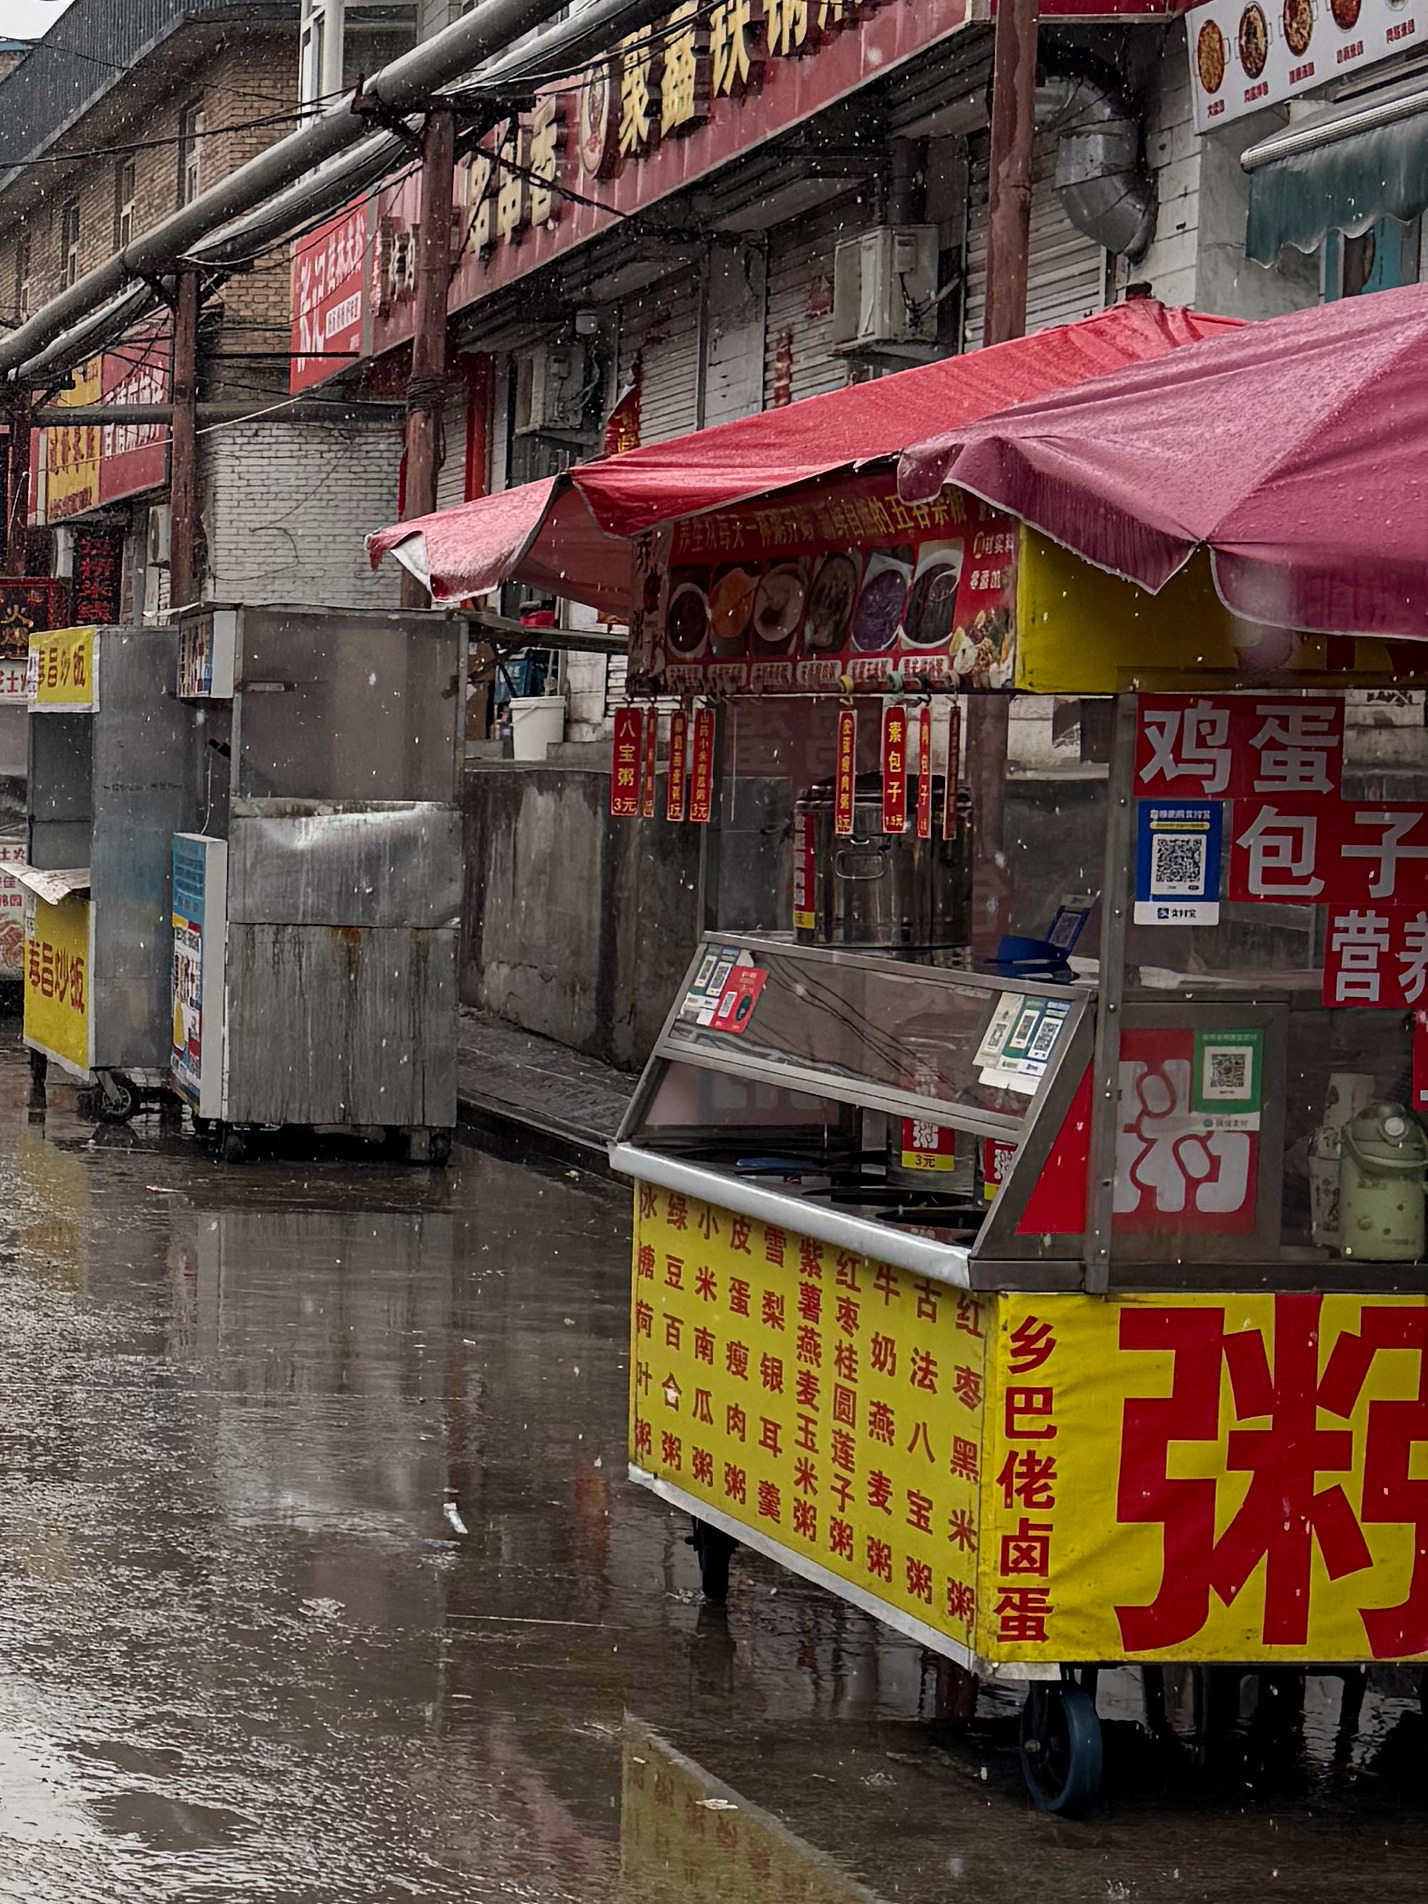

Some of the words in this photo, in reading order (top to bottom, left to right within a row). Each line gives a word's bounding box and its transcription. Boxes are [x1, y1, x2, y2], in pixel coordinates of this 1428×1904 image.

[613, 797, 637, 813] 3元
[617, 719, 637, 787] 八宝粥
[888, 720, 903, 803] 素包子
[1139, 699, 1339, 794] 鸡蛋
[1236, 804, 1428, 898] 包子
[915, 1155, 937, 1169] 3元
[661, 1192, 689, 1472] 绿豆百合粥
[691, 1205, 720, 1488] 小米南瓜粥
[724, 1216, 753, 1506] 皮蛋瘦肉粥
[756, 1226, 787, 1525] 雪梨银耳羹
[792, 1237, 824, 1543] 紫薯燕麦玉米粥
[828, 1252, 862, 1563] 红枣桂圆莲子粥
[866, 1266, 901, 1584] 牛奶燕麦粥
[905, 1280, 942, 1605] 古法八宝粥
[947, 1296, 985, 1633] 红枣黑米粥
[996, 1315, 1058, 1645] 乡巴佬卤蛋
[1114, 1293, 1428, 1662] 粥
